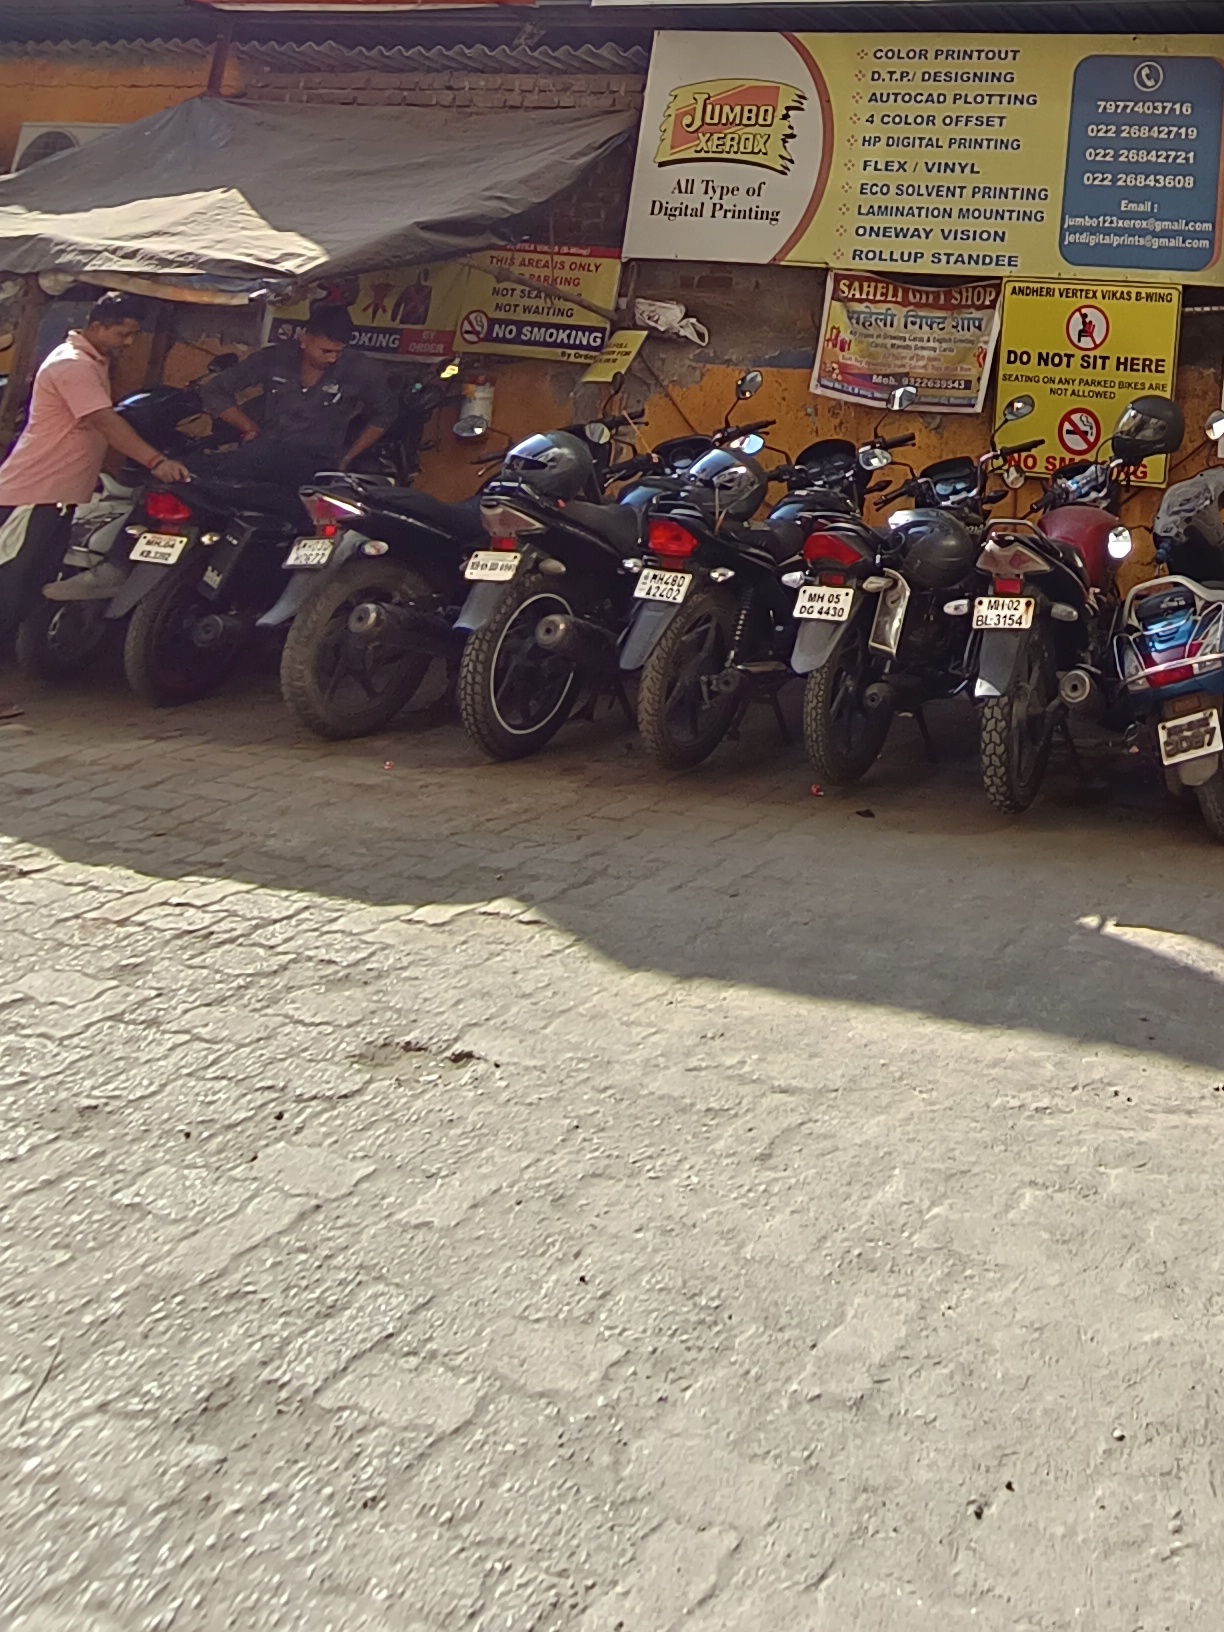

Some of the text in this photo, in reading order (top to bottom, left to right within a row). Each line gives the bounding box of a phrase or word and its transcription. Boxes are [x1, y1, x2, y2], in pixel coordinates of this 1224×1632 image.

[872, 48, 1021, 62] COLOR PRINTOUT
[867, 92, 1038, 107] AUTOCAD PLOTTING
[1097, 101, 1192, 115] 7977403716
[681, 92, 775, 132] JUMBO
[1087, 124, 1198, 140] 022 26842719
[694, 132, 771, 155] XEROX
[671, 179, 766, 201] All Type of
[649, 200, 781, 225] Digital Printing
[851, 248, 1019, 268] ROLLUP STANDEE
[839, 279, 902, 302] SAHELI
[951, 287, 996, 305] SHOP
[1010, 286, 1173, 303] ANDHERI VERTEX VIKAS B-WING
[494, 303, 574, 319] NOT WAITING
[492, 324, 603, 347] NO SMOKING
[1006, 349, 1166, 374] DO NOT SIT HERE
[1001, 373, 1167, 393] SEATING ON ANY PARKED BIKES ARE
[1049, 387, 1116, 400] NOT ALLOWED
[807, 592, 841, 604] MH 05
[817, 606, 845, 618] 4430
